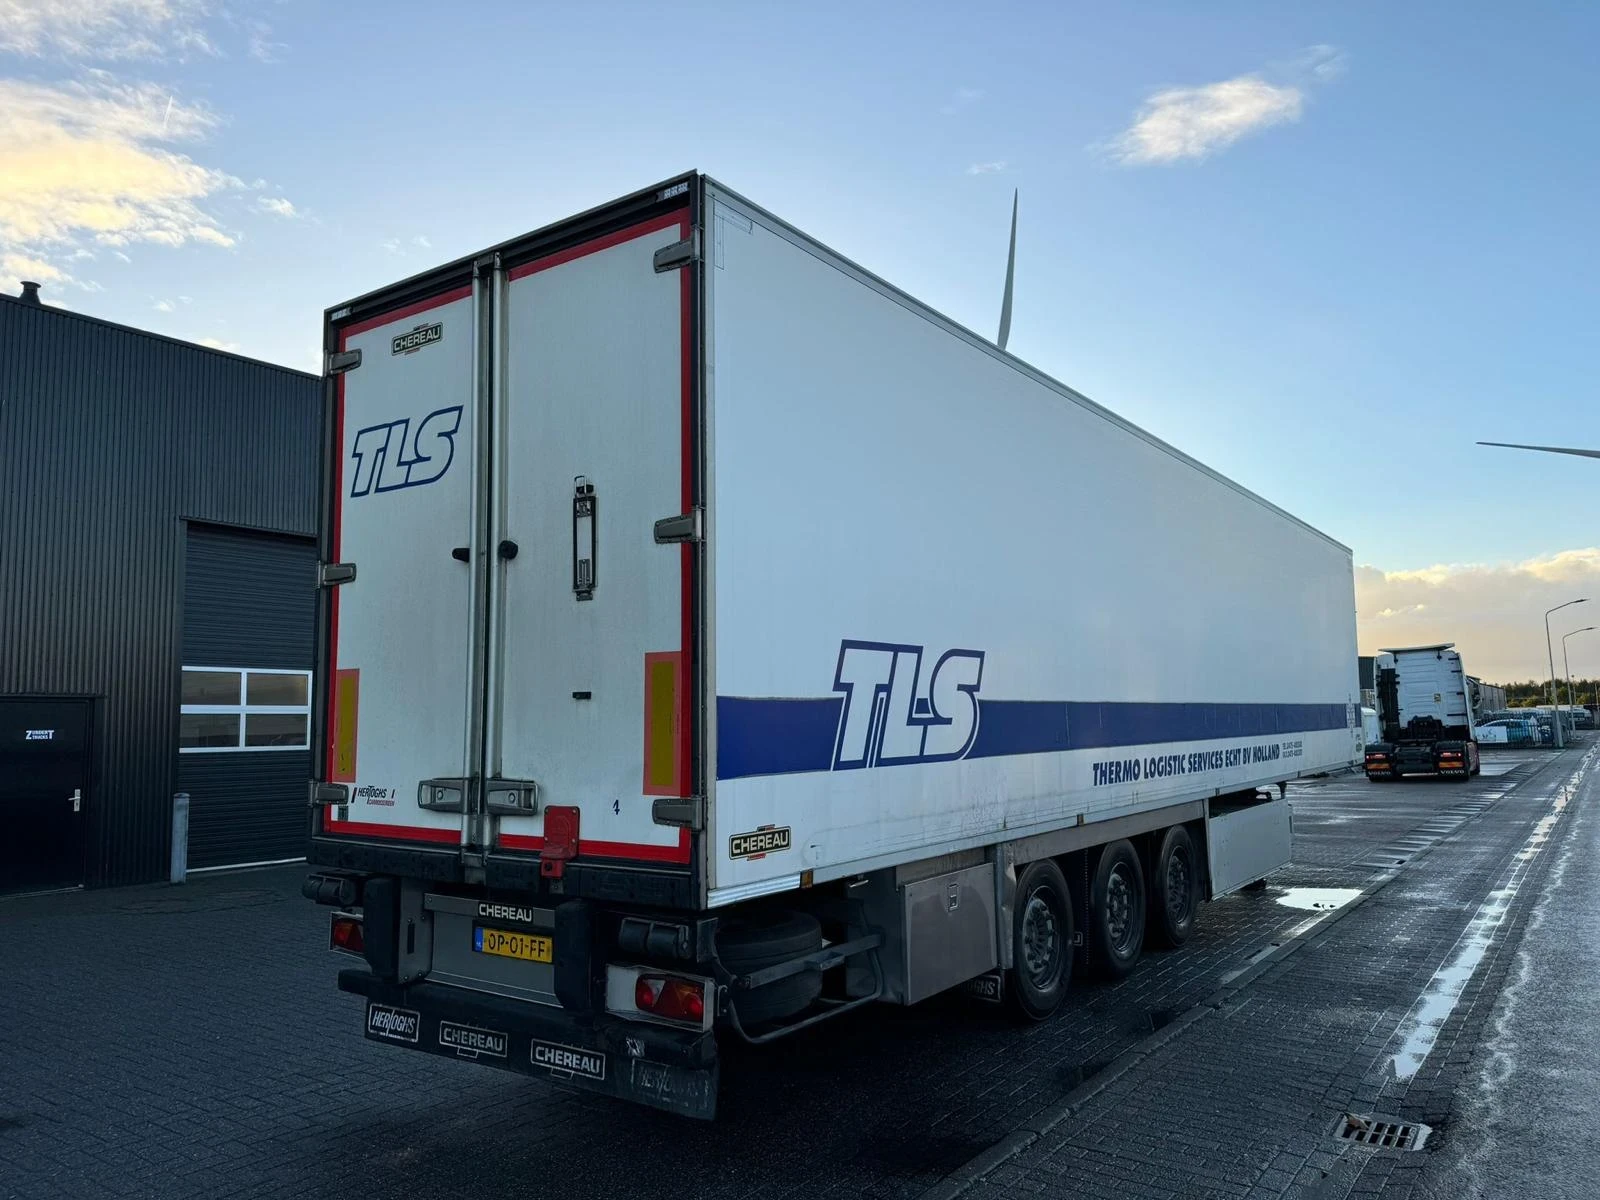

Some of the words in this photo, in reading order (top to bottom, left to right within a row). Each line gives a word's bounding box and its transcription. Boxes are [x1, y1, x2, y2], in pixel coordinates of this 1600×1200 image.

[394, 326, 441, 351] CHEREAU
[350, 405, 463, 497] TLS
[832, 639, 985, 771] TLS
[1093, 758, 1141, 787] THERMO
[1143, 753, 1186, 779] LOGISTIC
[1187, 750, 1223, 773] SERVICES
[1225, 748, 1241, 768] ECHT
[1242, 747, 1252, 764] BV
[1252, 743, 1280, 764] HOLLAND
[358, 786, 387, 804] HERTOGHS
[732, 831, 789, 854] CHEREAU
[479, 903, 533, 922] CHEREAU
[488, 933, 546, 958] OP-01-FF
[372, 1009, 416, 1036] HERTOGHS
[443, 1027, 504, 1052] CHEREAU
[535, 1046, 601, 1074] CHEREAU
